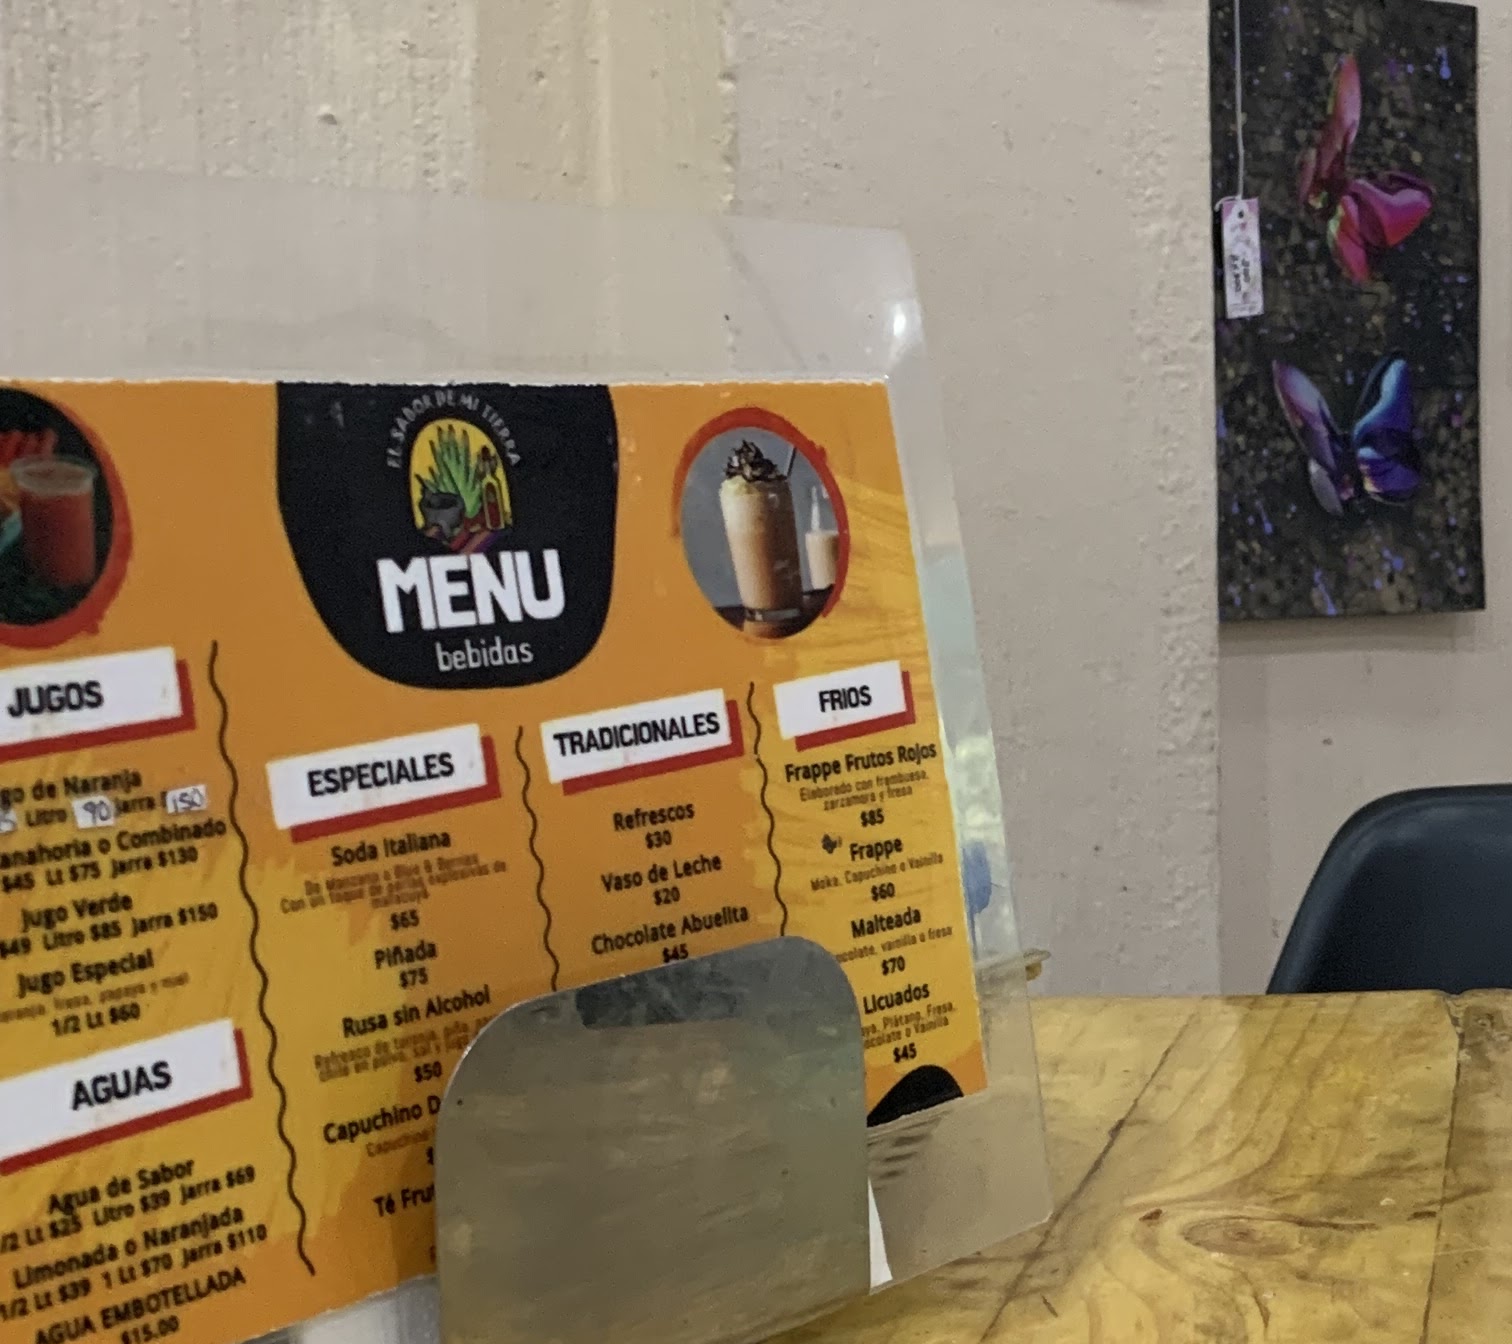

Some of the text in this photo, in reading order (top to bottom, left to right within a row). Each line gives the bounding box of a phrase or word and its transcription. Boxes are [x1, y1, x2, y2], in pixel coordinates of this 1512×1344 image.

[376, 549, 565, 633] MENU
[435, 636, 534, 672] bebidas
[8, 680, 104, 718] JUGOS
[818, 685, 872, 713] FRIOS
[553, 712, 720, 756] TRADICIONALES
[307, 752, 454, 797] ESPECIALES
[785, 743, 937, 783] Frappe Frutos Rojos
[32, 778, 56, 801] de
[63, 768, 142, 796] Naranja
[83, 800, 112, 825] 90
[613, 804, 695, 831] Refrescos
[860, 808, 884, 827] $85
[117, 818, 227, 852] Combinado
[331, 832, 451, 867] Soda Italiana
[645, 830, 672, 850] $30
[849, 837, 903, 862] Frappe
[69, 860, 101, 883] $75
[158, 846, 198, 868] $130
[601, 854, 722, 893] Vaso de Leche
[653, 886, 681, 906] $20
[871, 882, 896, 902] $60
[21, 892, 133, 933] Jugo Verde
[178, 902, 219, 926] $150
[390, 909, 420, 931] $65
[850, 906, 921, 939] Malteada
[591, 906, 749, 955] Chocolate Abuelita
[662, 944, 689, 963] $45
[880, 955, 906, 976] $70
[17, 970, 66, 999] Jugo
[70, 948, 154, 984] Especial
[399, 967, 429, 989] $75
[109, 1002, 141, 1024] $60
[342, 984, 490, 1038] Rusa sin Alcohol
[863, 983, 931, 1015] Licuados
[893, 1042, 917, 1063] $45
[72, 1060, 172, 1111] AGUAS
[413, 1061, 442, 1083] $50
[323, 1103, 422, 1144] Capuchino
[48, 1159, 195, 1217] Agua de Sabor
[13, 1206, 244, 1291] Limonada o Naranjada
[227, 1223, 268, 1250] $110
[101, 1267, 246, 1330] EMBOTELLADA
